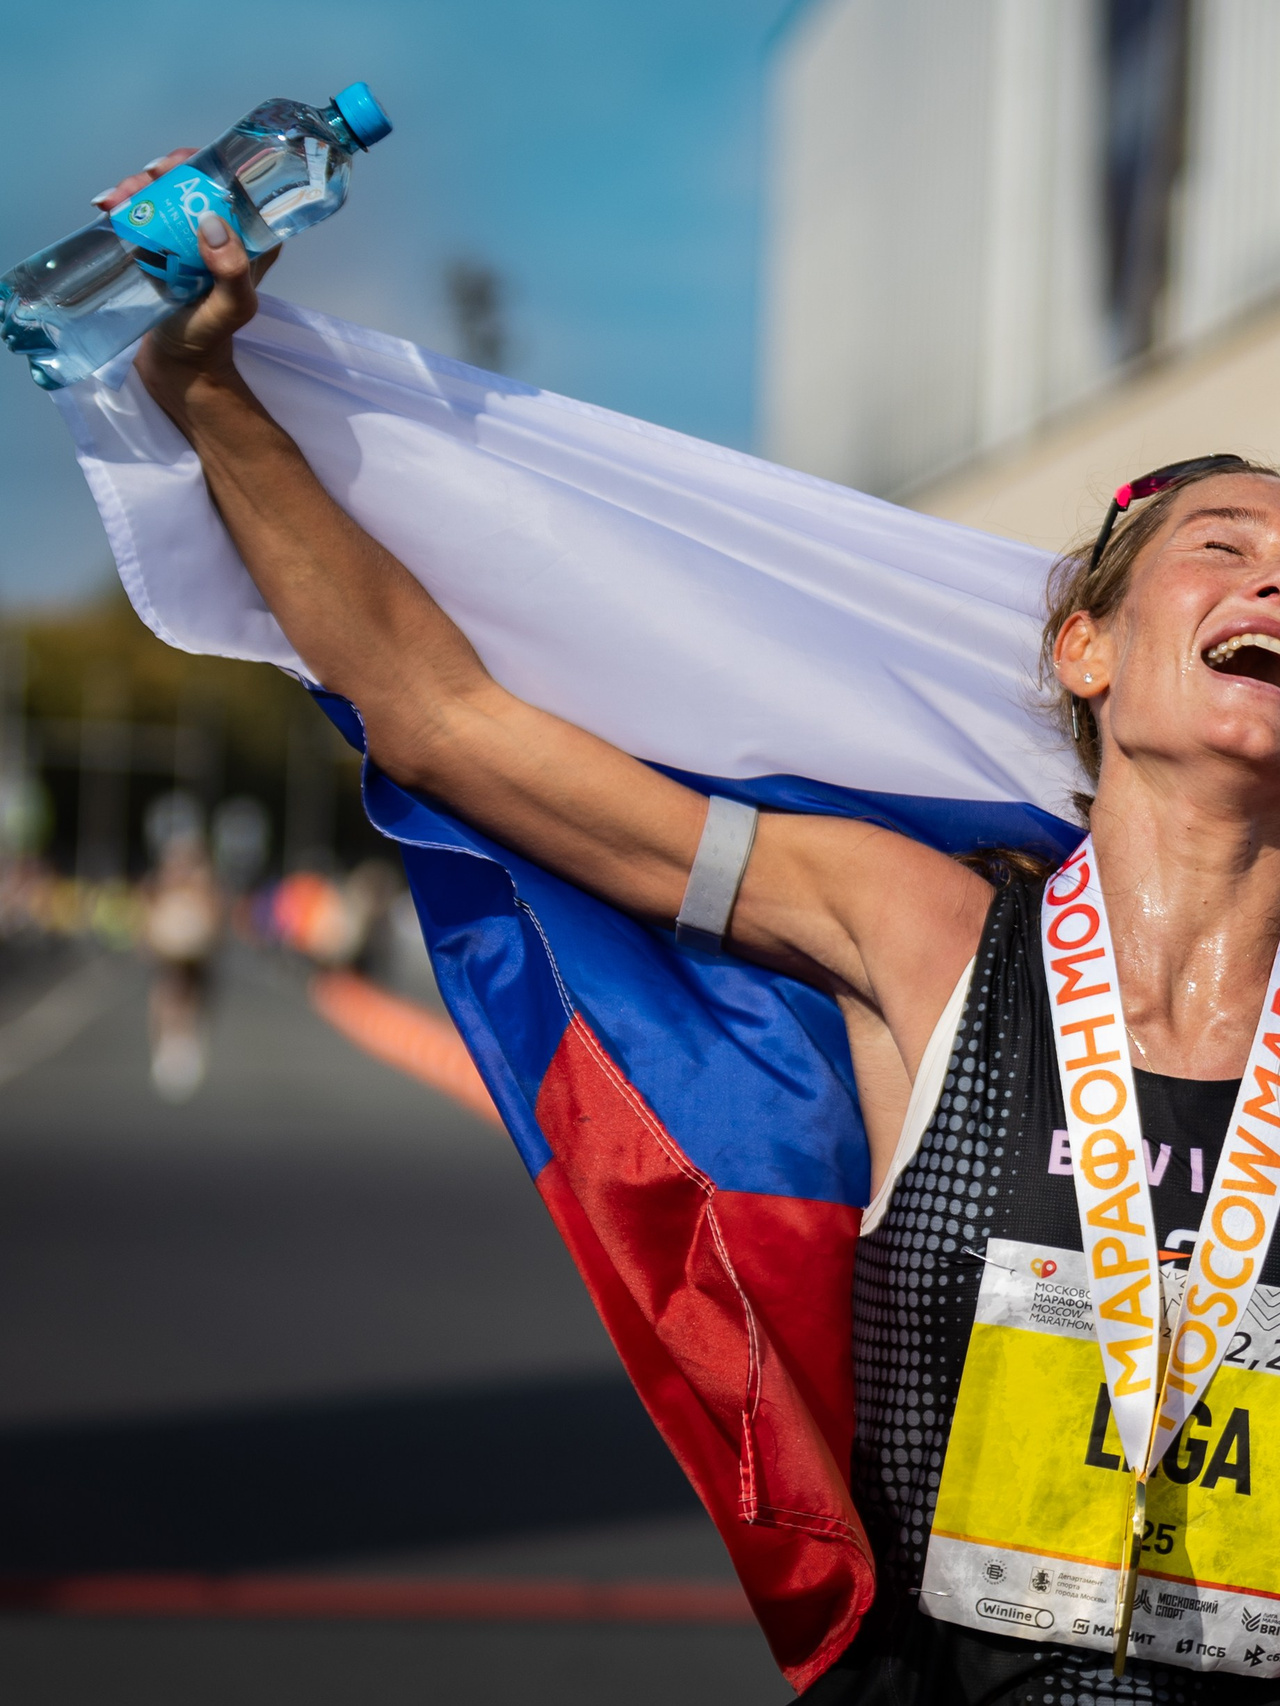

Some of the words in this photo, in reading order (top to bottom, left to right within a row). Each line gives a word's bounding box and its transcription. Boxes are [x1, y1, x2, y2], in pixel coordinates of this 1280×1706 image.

[1061, 1013, 1154, 1398] МАРАФОН
[1034, 1281, 1092, 1300] МОСКОВС
[1030, 1302, 1085, 1319] MOSCOW
[1033, 1292, 1093, 1311] МАРАФОН
[1028, 1313, 1094, 1331] MARATHON
[1084, 1382, 1252, 1496] LGA
[1056, 1581, 1081, 1591] спорта
[1057, 1572, 1104, 1587] Департамент
[1055, 1589, 1079, 1600] города
[1079, 1592, 1107, 1604] Москвы
[1156, 1592, 1219, 1615] МОСКОВСКИЙ
[982, 1602, 1033, 1622] Winline
[1155, 1605, 1185, 1621] СПОРТ
[1092, 1623, 1156, 1646] МАНИТ
[1195, 1643, 1227, 1658] ПСБ
